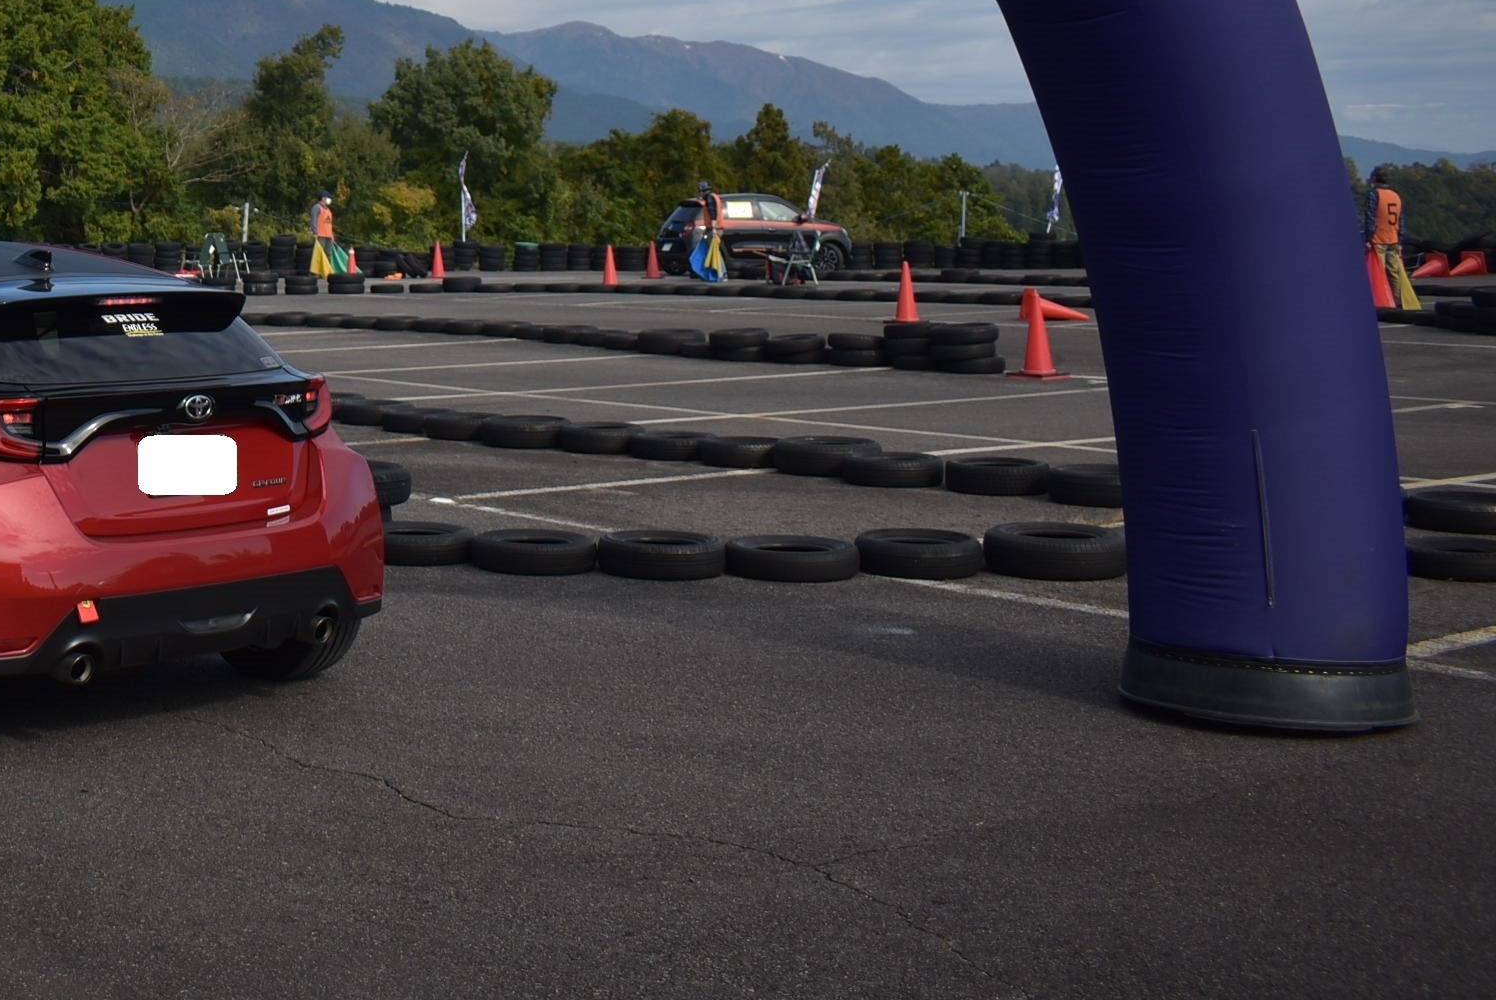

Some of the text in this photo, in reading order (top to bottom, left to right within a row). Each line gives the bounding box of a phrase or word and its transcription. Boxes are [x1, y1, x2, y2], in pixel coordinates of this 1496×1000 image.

[1387, 203, 1398, 225] 5
[101, 312, 159, 323] BRIDE
[122, 322, 158, 332] ENDLESS
